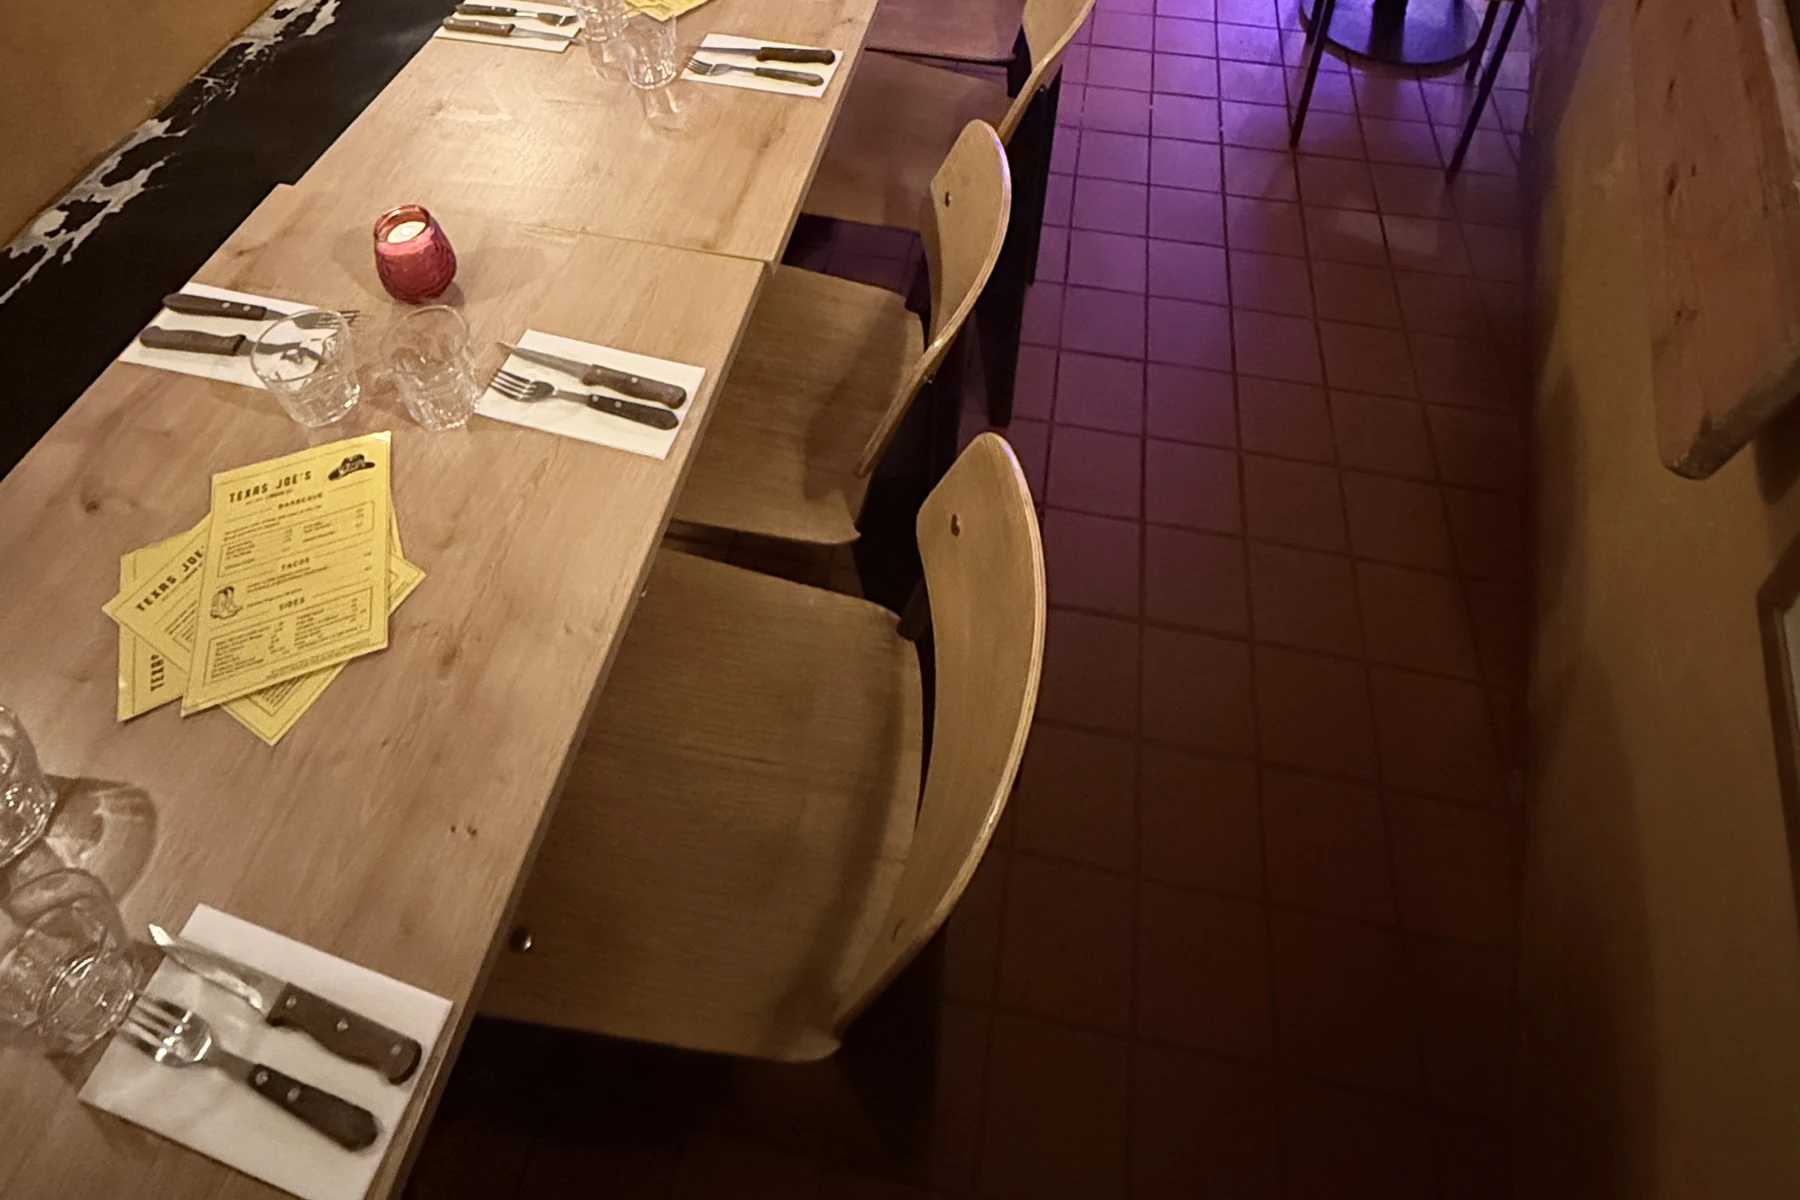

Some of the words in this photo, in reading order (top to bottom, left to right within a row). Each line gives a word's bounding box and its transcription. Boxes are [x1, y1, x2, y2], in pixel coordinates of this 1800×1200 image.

[229, 483, 269, 503] TEXAS
[276, 471, 312, 490] JOE'S
[136, 575, 177, 612] TEXAS
[182, 545, 205, 572] JOE'
